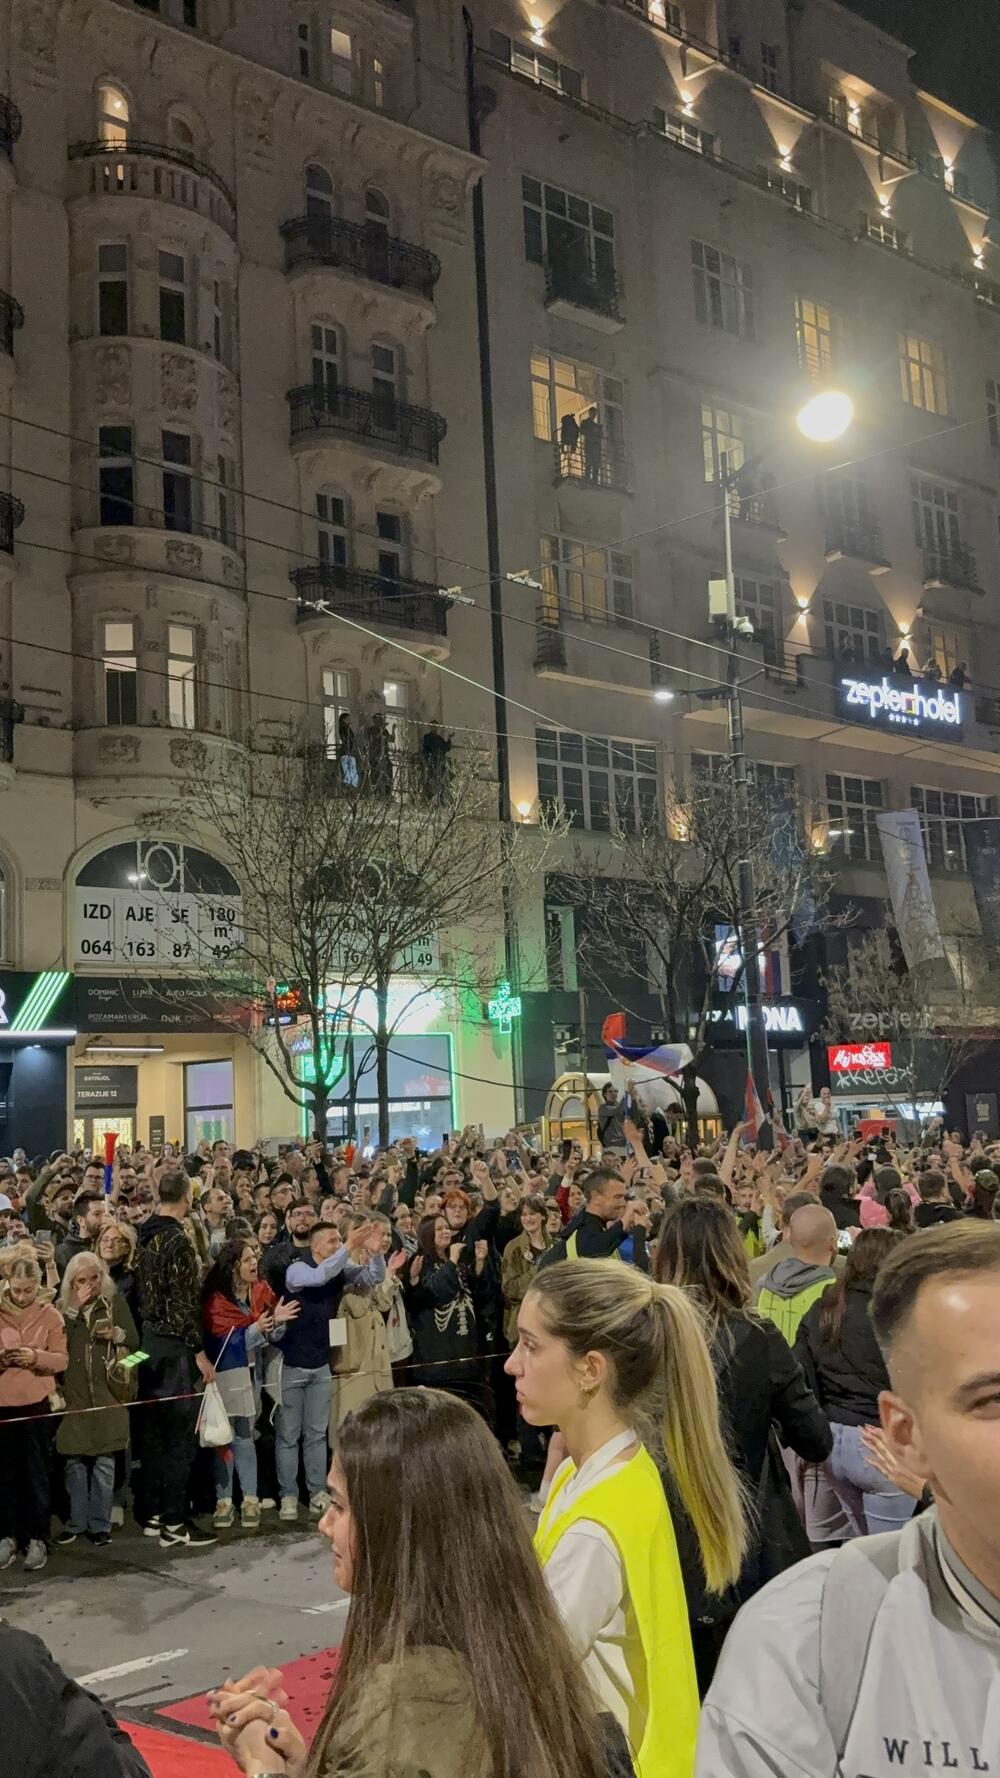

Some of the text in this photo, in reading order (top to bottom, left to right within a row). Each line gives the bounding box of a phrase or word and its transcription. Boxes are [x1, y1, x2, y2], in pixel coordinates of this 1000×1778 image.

[83, 904, 112, 919] IZD
[126, 906, 154, 922] AJE
[208, 908, 235, 921] 180
[81, 939, 231, 959] 064 163 87 49
[417, 953, 433, 966] 49
[882, 1736, 989, 1771] WILL
